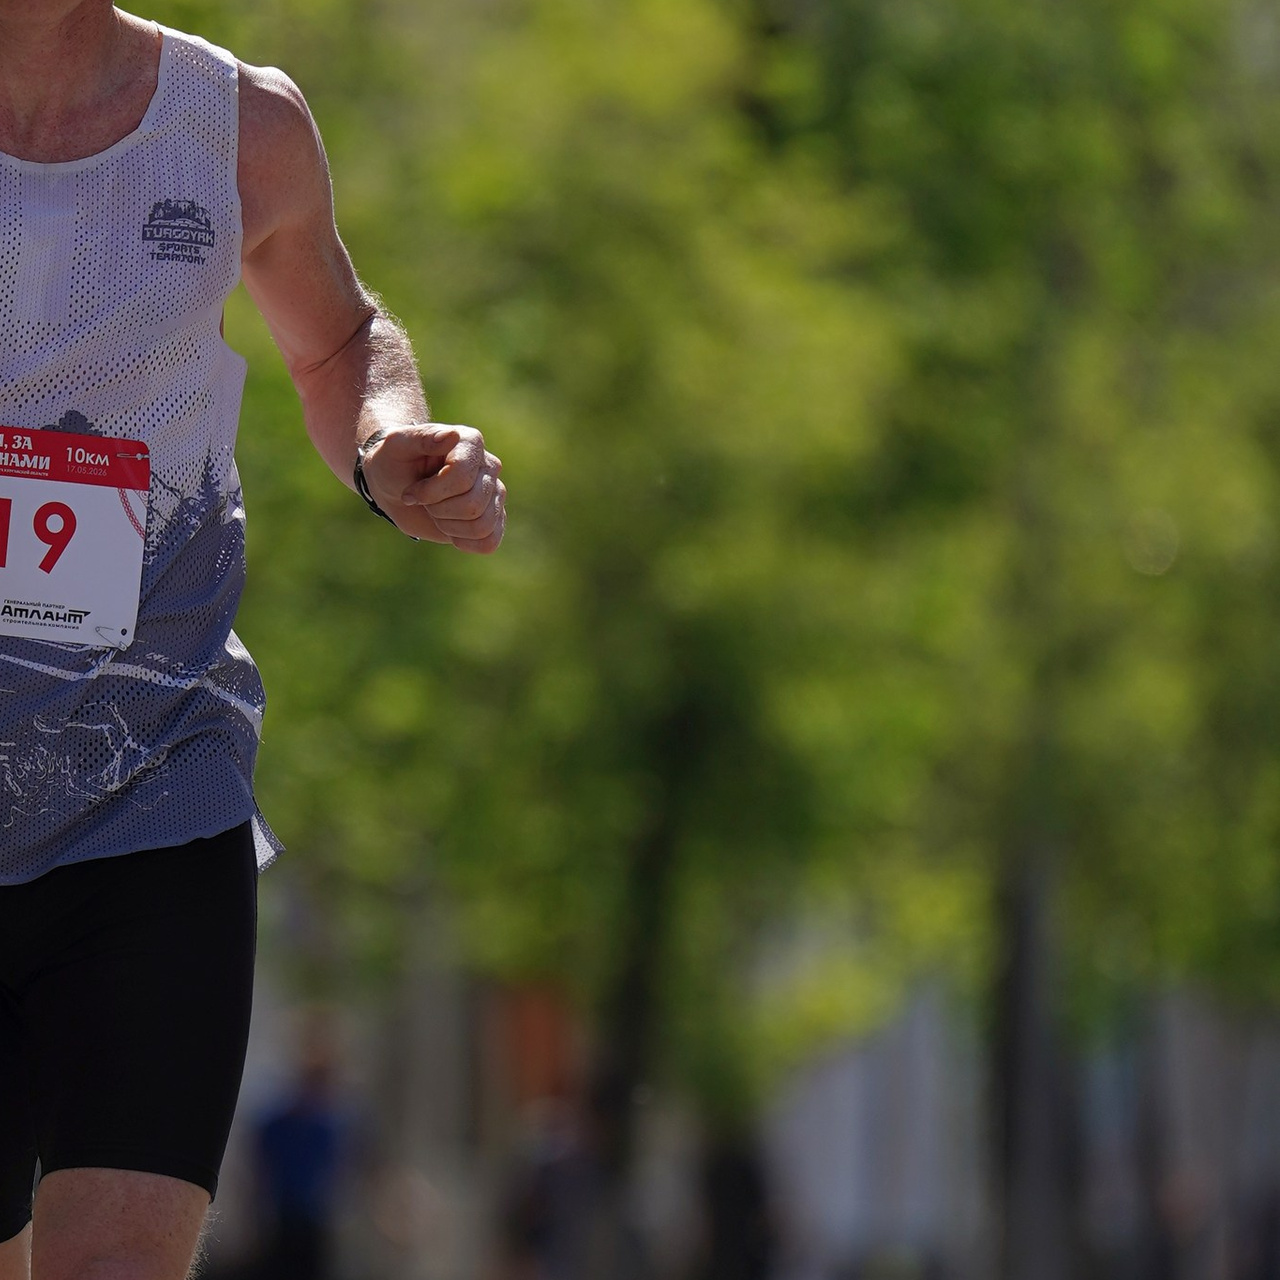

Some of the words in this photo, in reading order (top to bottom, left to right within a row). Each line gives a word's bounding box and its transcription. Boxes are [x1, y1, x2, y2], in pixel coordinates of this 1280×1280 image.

[158, 242, 201, 254] SPORTS
[149, 252, 207, 265] TERRITORY
[11, 434, 33, 450] ЗА
[67, 465, 107, 477] 17.05.2026
[2, 618, 47, 627] строительная
